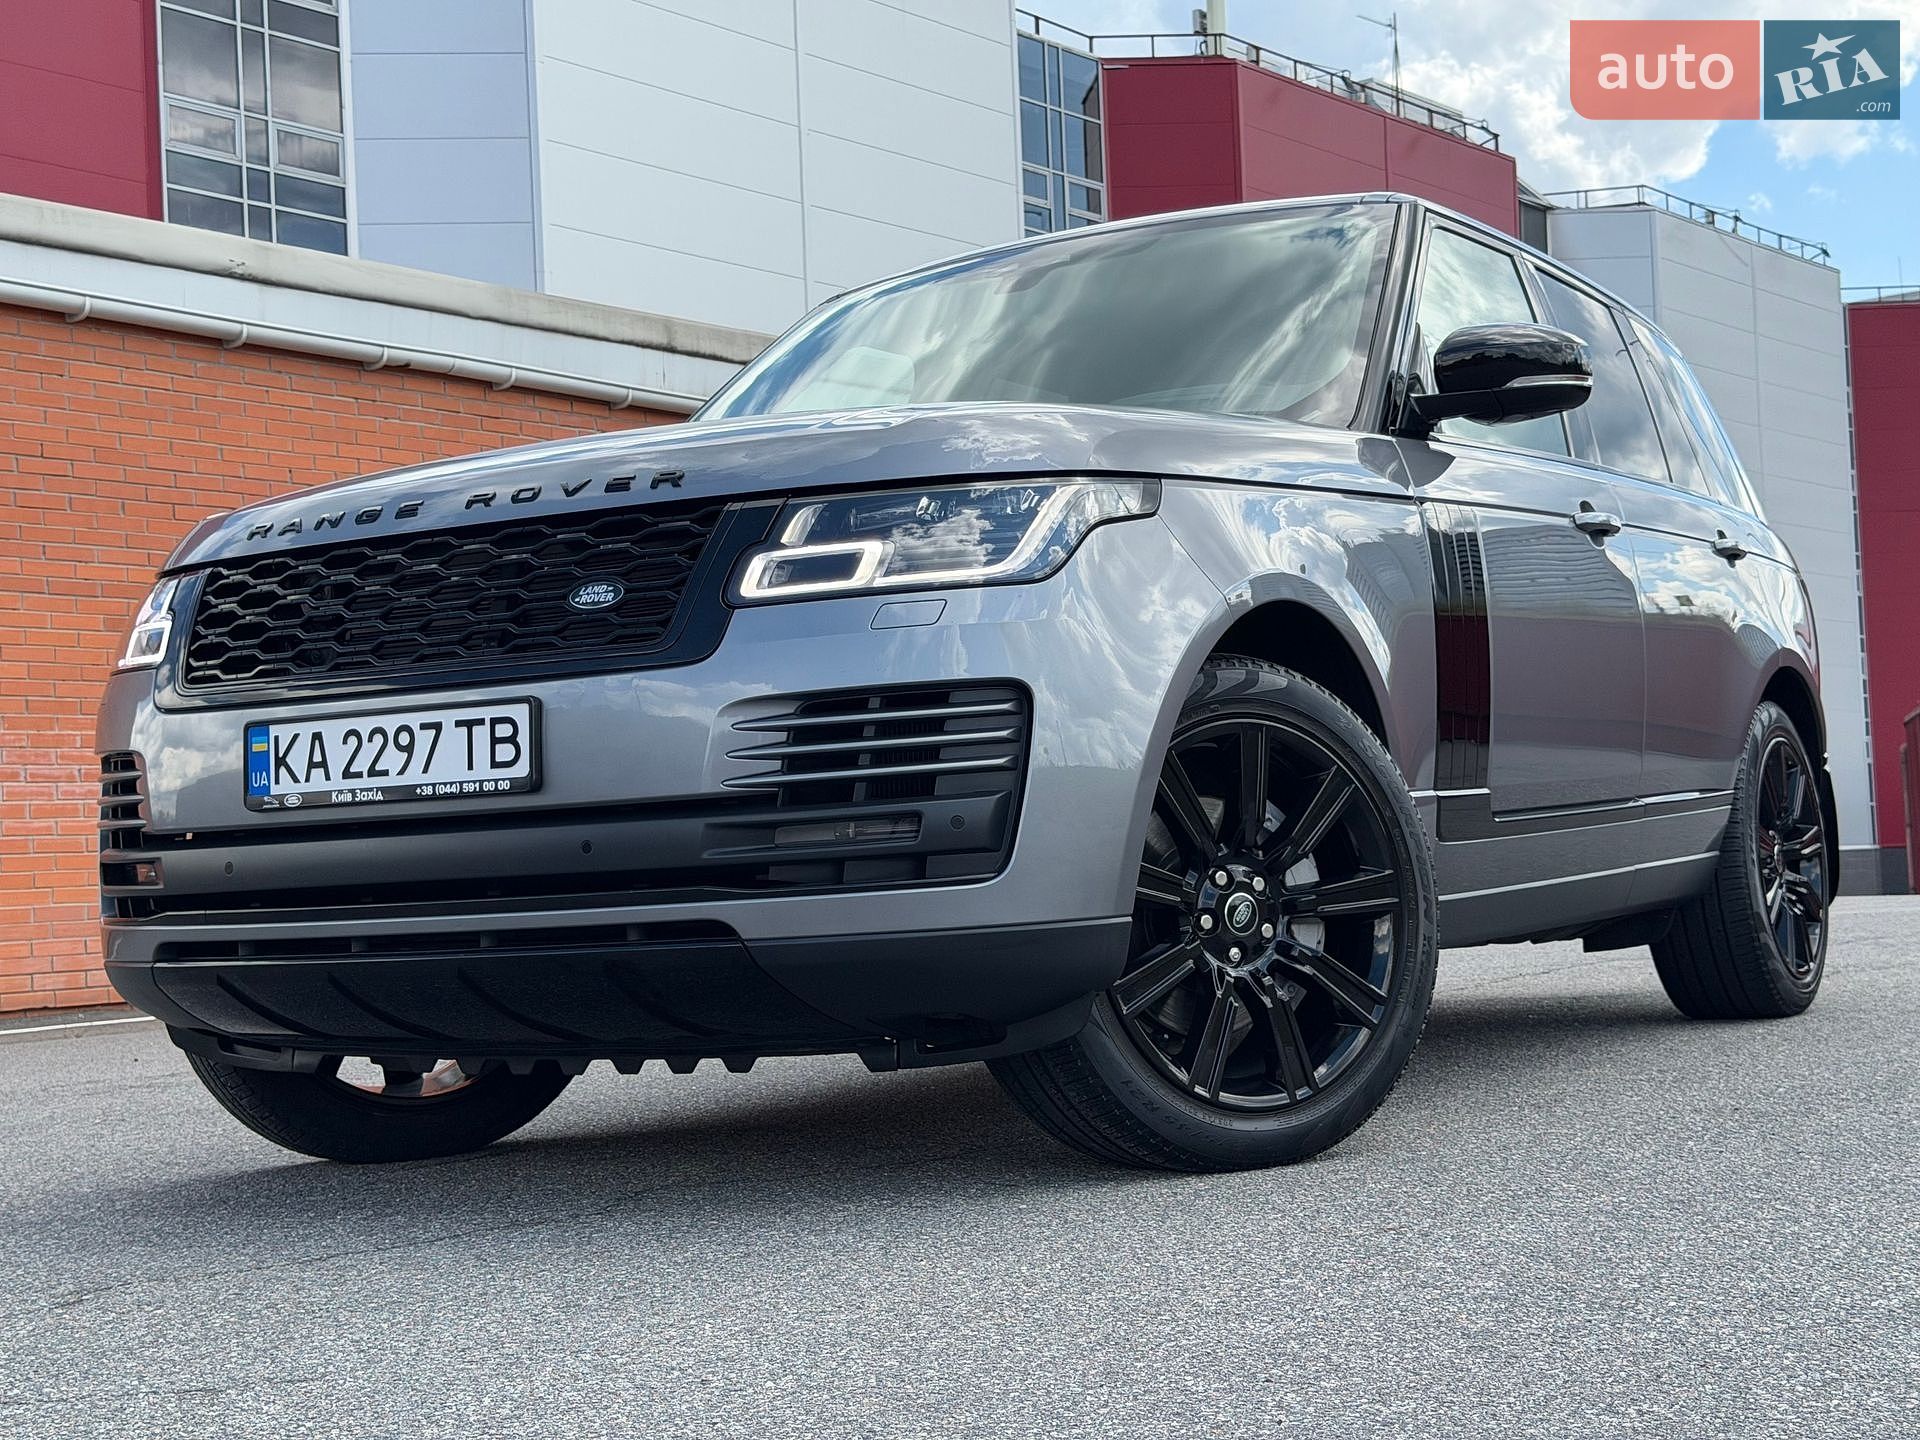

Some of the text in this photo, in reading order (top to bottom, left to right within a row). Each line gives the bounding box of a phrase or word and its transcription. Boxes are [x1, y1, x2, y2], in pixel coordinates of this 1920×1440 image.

[246, 469, 686, 542] RANGE ROVER
[273, 715, 522, 786] KA 2297 TB
[252, 771, 269, 788] UA
[331, 788, 384, 803] Київ Захід
[415, 780, 511, 797] +38 (044) 591 00 00
